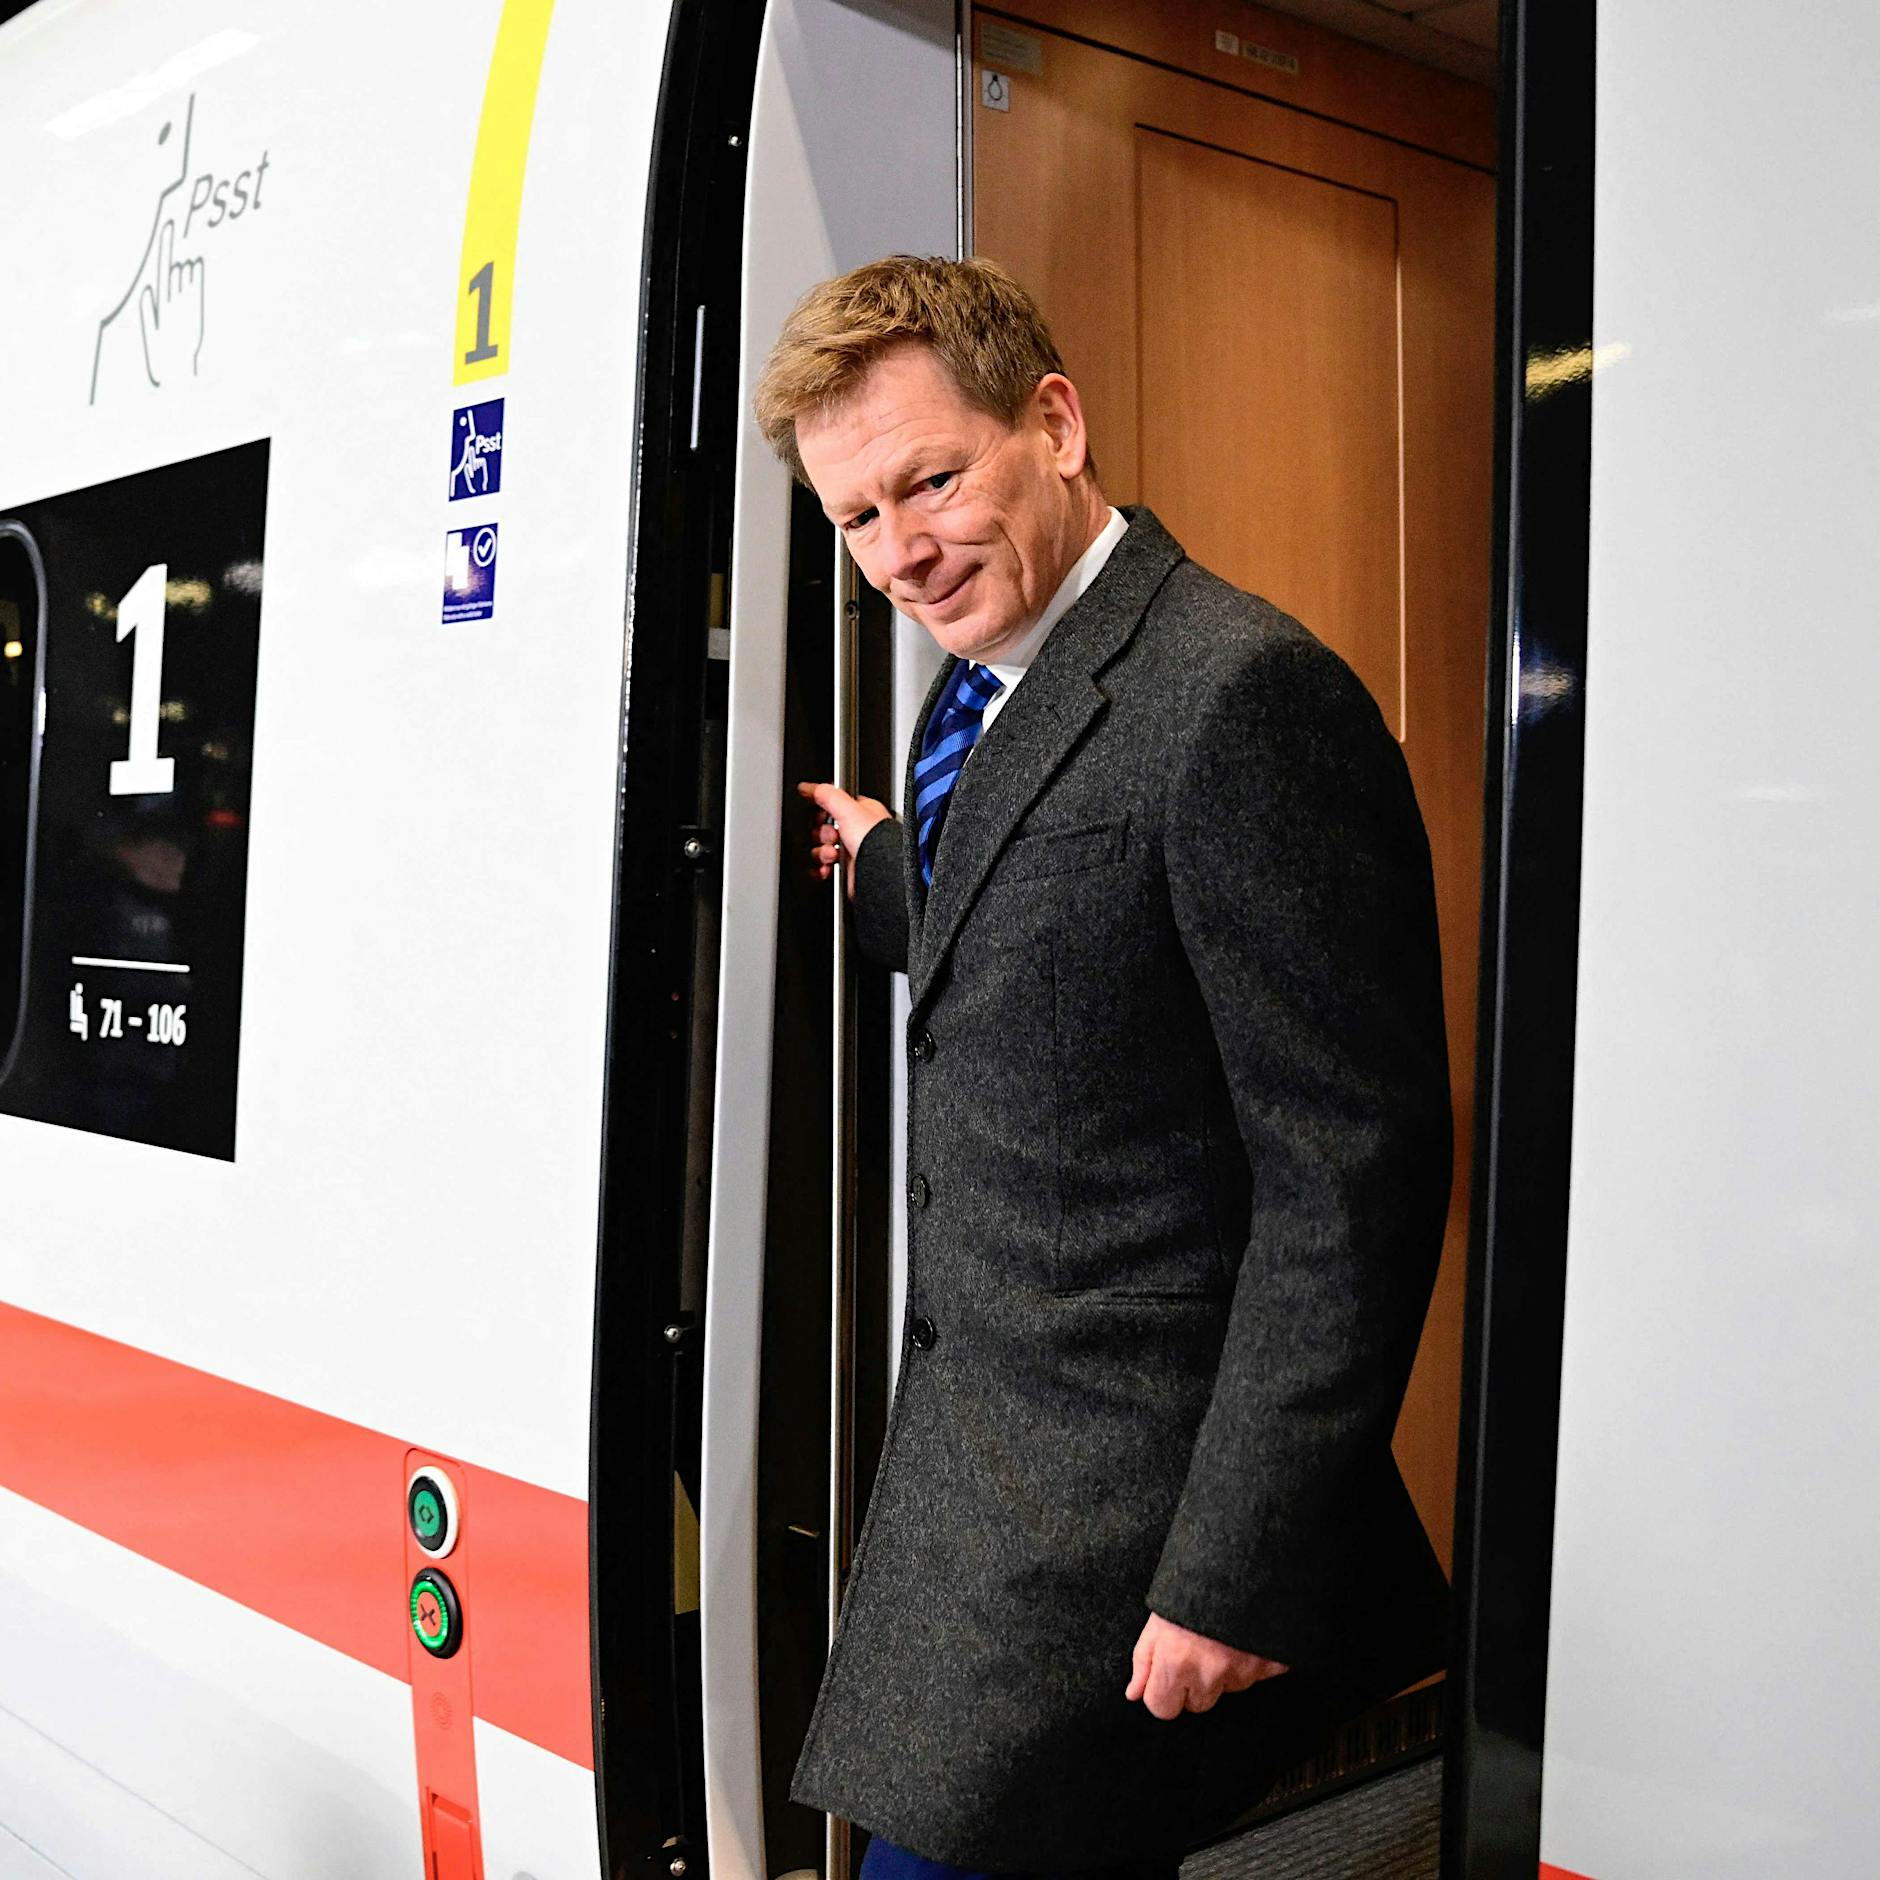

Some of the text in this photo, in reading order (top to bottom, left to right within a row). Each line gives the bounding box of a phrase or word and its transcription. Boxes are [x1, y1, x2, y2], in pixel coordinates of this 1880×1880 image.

[184, 149, 270, 238] Psst
[466, 262, 498, 365] 1
[475, 431, 502, 455] Psst
[110, 564, 175, 796] 1
